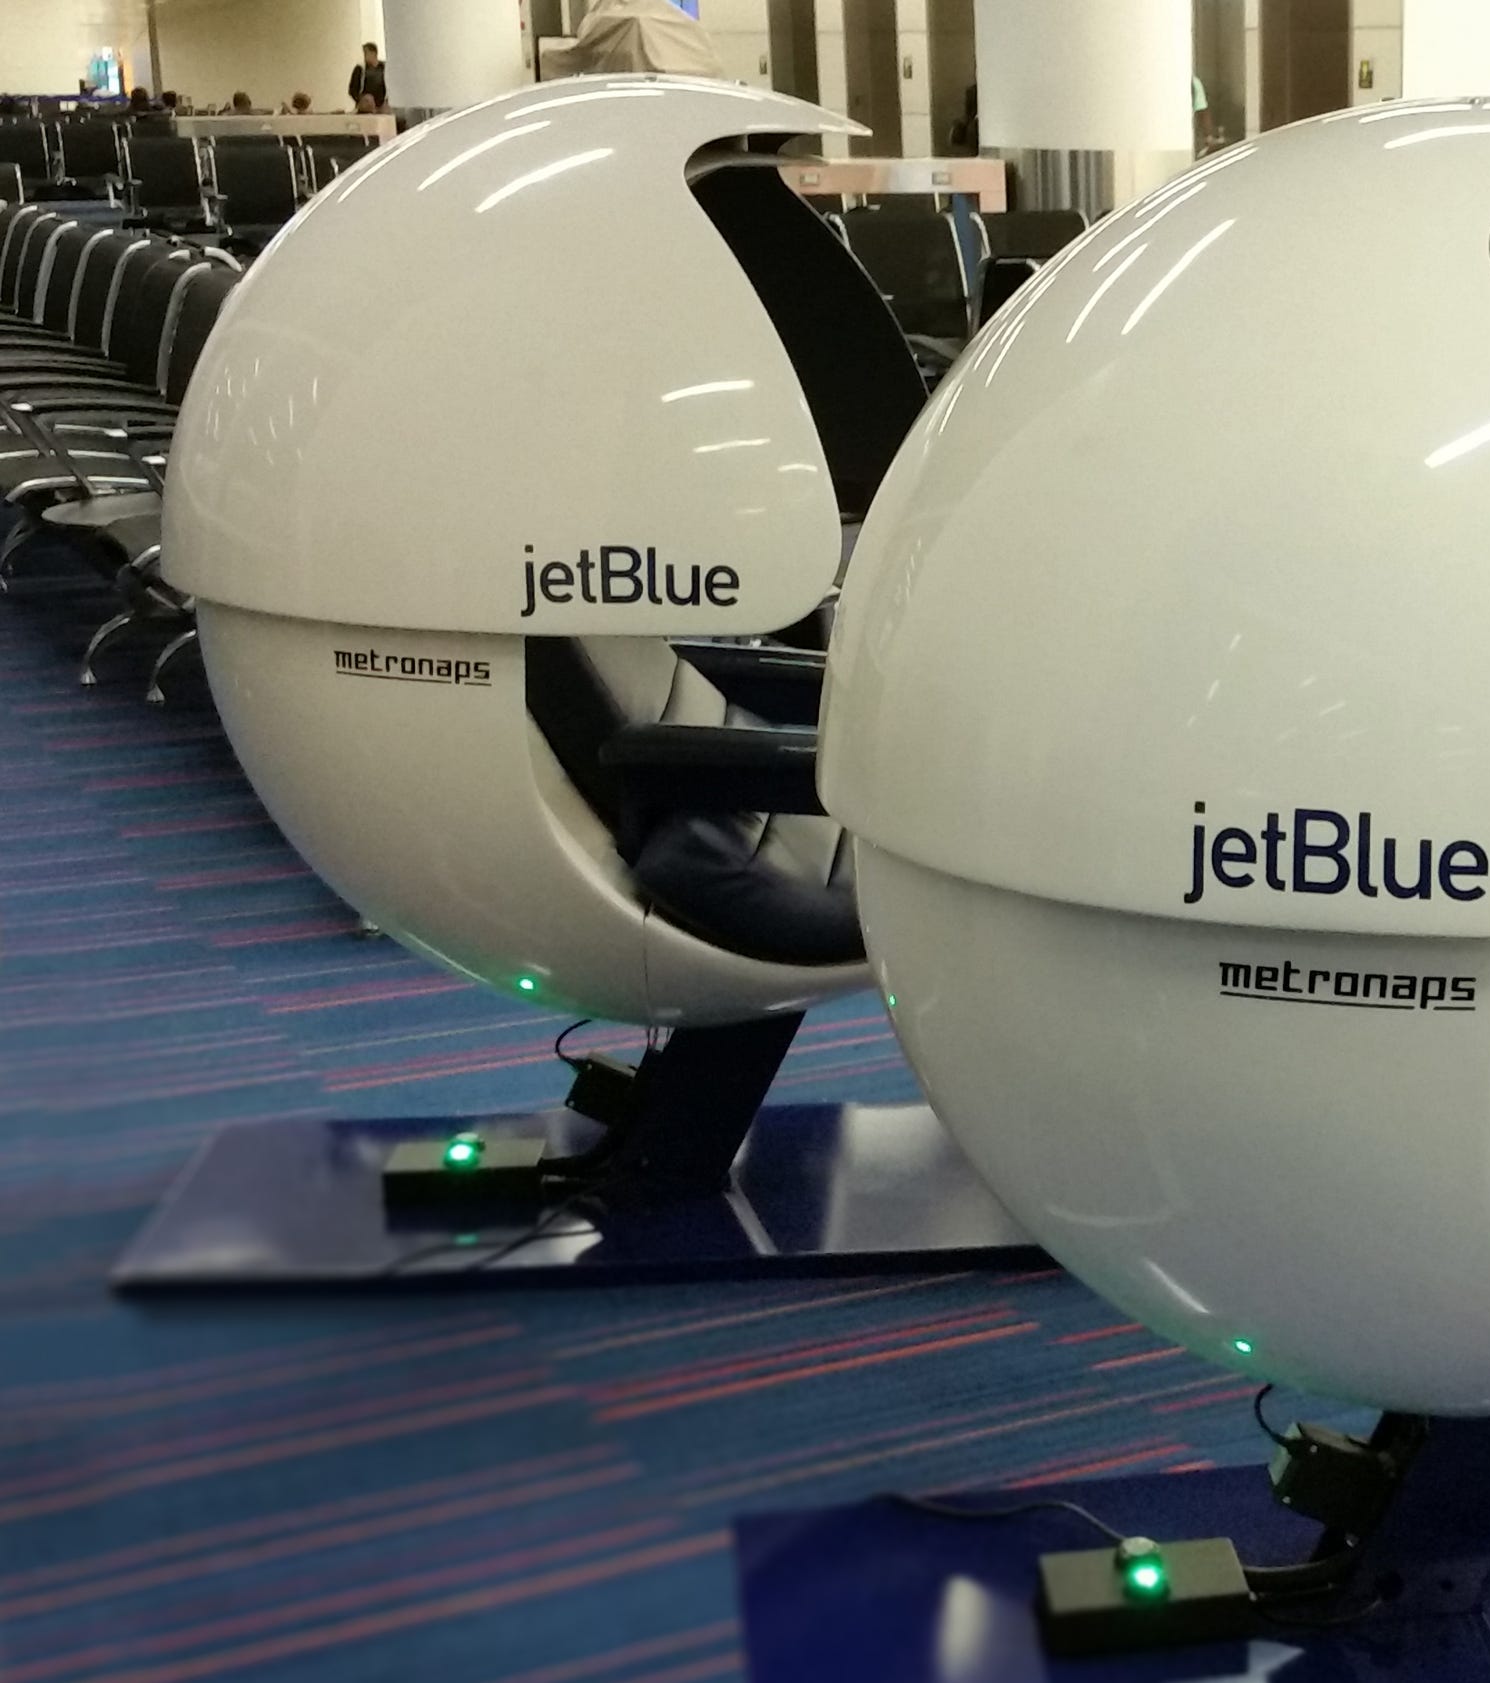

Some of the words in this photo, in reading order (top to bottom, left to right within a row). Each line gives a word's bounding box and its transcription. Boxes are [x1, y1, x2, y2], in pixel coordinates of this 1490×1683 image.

[520, 544, 740, 617] jetBlue
[333, 648, 491, 685] metronaps
[1183, 801, 1489, 904] jetBlue
[1218, 960, 1477, 1010] metronaps
